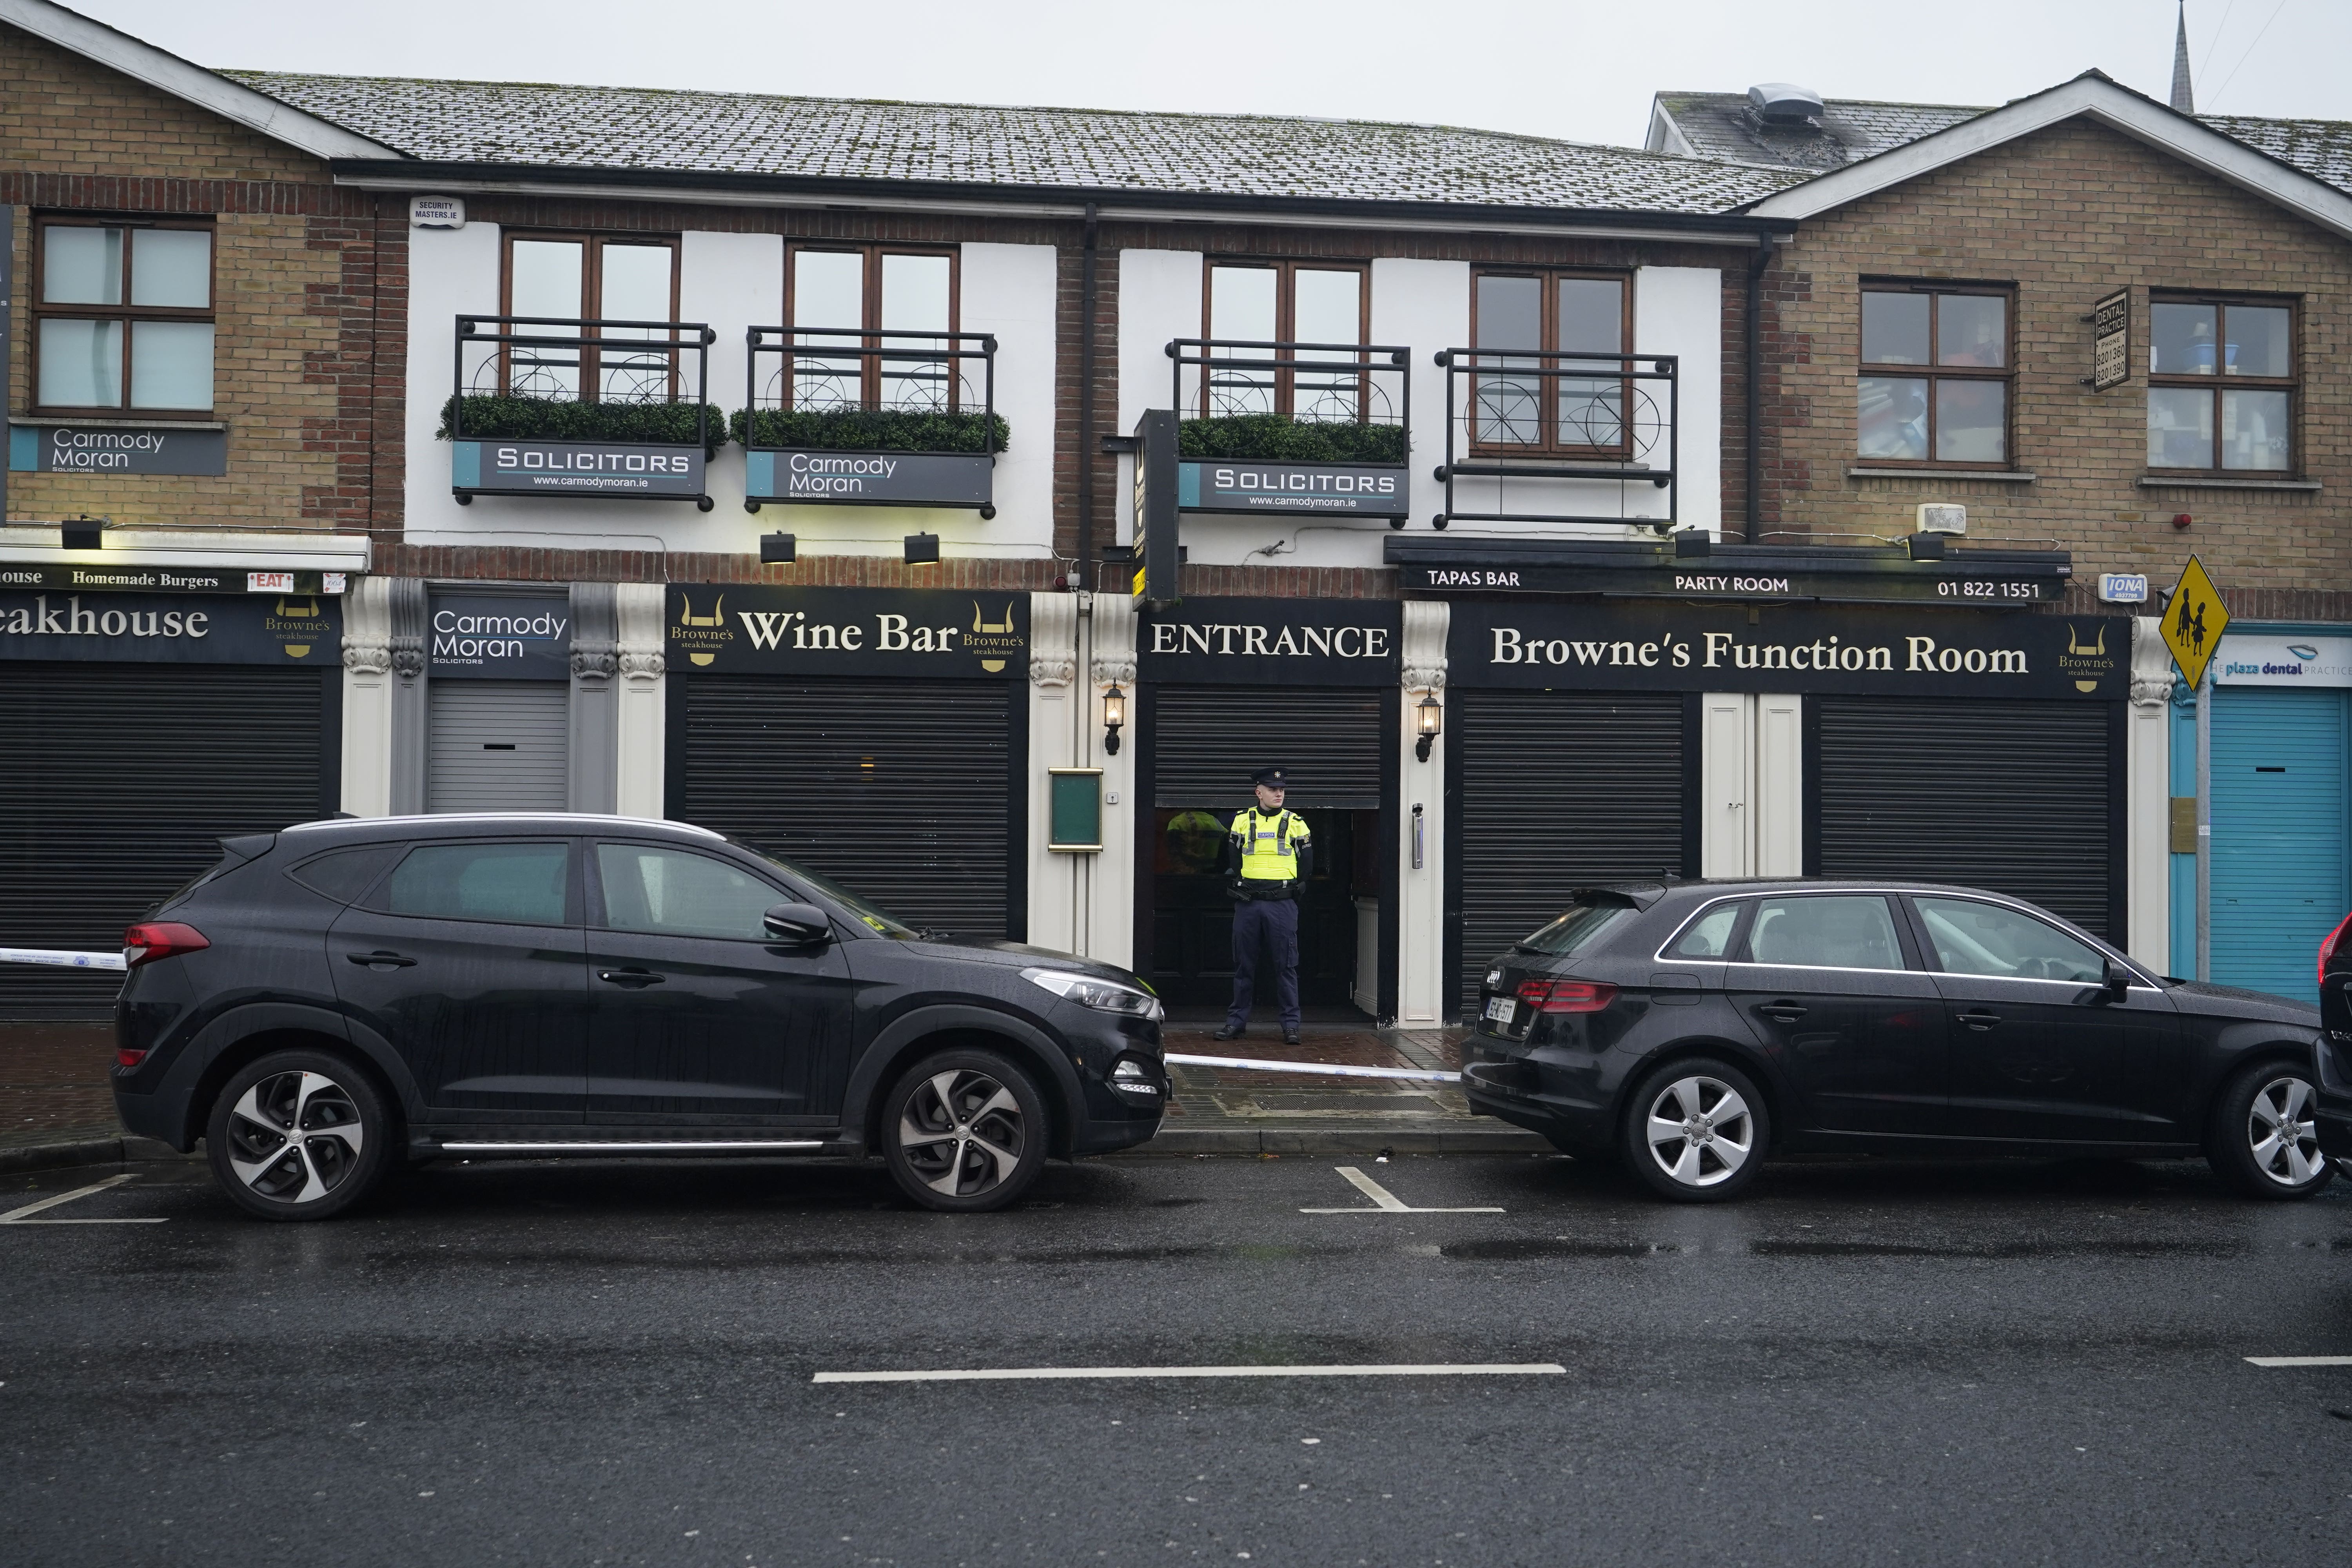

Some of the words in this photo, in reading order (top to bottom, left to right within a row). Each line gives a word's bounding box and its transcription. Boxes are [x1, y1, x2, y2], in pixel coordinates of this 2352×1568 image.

[2098, 303, 2124, 324] DENTAL
[2098, 316, 2124, 338] PRACTICE
[2101, 336, 2120, 349] PHONE
[2097, 344, 2125, 366] 8201360
[2097, 361, 2125, 382] 8201390
[54, 429, 164, 453] Carmody
[53, 448, 127, 466] Moran
[497, 448, 690, 472] SOLICITORS
[790, 454, 897, 478] Carmody
[534, 477, 648, 488] www.carmodymoran.ie
[790, 474, 861, 492] Moran
[1216, 470, 1396, 492] SOLICITORS
[1250, 497, 1356, 507] www.carmodymoran.ie
[73, 572, 155, 585] Homemade
[160, 574, 218, 589] Burgers
[256, 573, 285, 587] EAT
[325, 579, 342, 587] 1664
[1428, 571, 1481, 584] TAPAS
[1487, 572, 1520, 586] BAR
[1676, 576, 1728, 590] PARTY
[1734, 577, 1788, 592] ROOM
[2109, 579, 2142, 592] IONA
[1938, 583, 1956, 595] 01
[1964, 582, 1994, 596] 822
[2001, 583, 2038, 597] 1551
[0, 594, 208, 637] akhouse
[264, 617, 330, 632] Browne's
[434, 610, 566, 640] Carmody
[670, 625, 734, 641] Browne's
[738, 612, 862, 650] Wine
[876, 615, 958, 652] Bar
[433, 635, 523, 657] Moran
[680, 641, 724, 649] steakhouse
[962, 632, 1025, 647] Browne's
[1151, 624, 1389, 657] ENTRANCE
[1491, 628, 1690, 667] Browne's
[1702, 633, 1893, 670] Function
[1906, 637, 2029, 673] Room
[2058, 655, 2114, 669] Browne's
[2226, 661, 2260, 677] plaza
[2261, 662, 2303, 675] dental
[2304, 666, 2352, 675] PRACTICE
